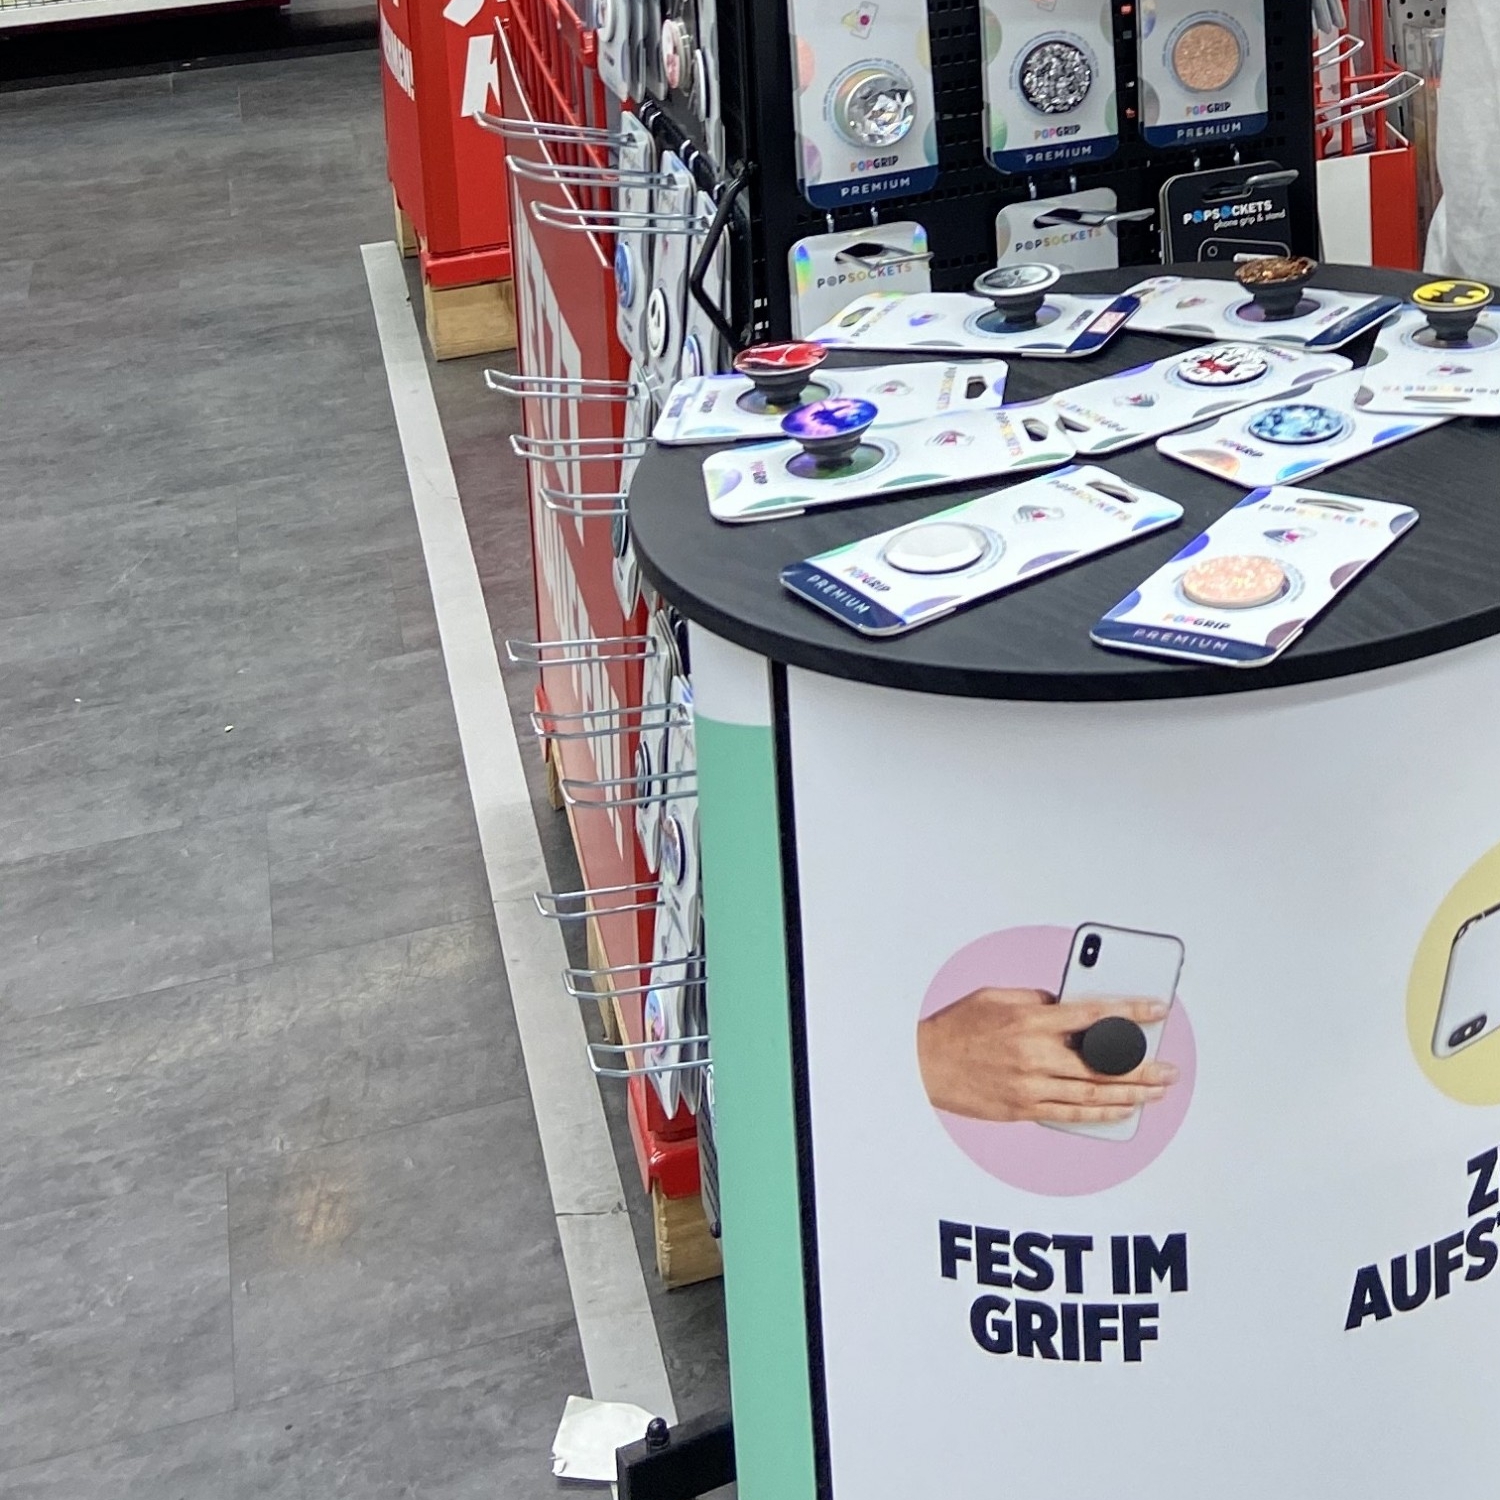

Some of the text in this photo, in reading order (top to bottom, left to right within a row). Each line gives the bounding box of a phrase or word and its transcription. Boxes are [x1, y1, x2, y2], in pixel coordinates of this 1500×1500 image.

[1186, 101, 1231, 116] POPGRIP
[1034, 124, 1081, 140] POPGRIP
[1177, 121, 1241, 139] PREMIUM
[850, 155, 899, 172] POPGRIP
[1025, 145, 1092, 164] PREMIUM
[841, 177, 910, 198] PREMIUM
[1183, 201, 1273, 224] POPSOCKETS
[1016, 227, 1099, 252] POPSOCKETS
[817, 263, 912, 288] POPSOCKETS
[843, 566, 890, 593] POPGRIP
[806, 574, 870, 615] PREMIUM
[1163, 613, 1231, 631] POPGRIP
[1134, 627, 1229, 652] PREMIUM
[939, 1219, 1188, 1295] FEST IM
[969, 1295, 1159, 1363] GRIFF
